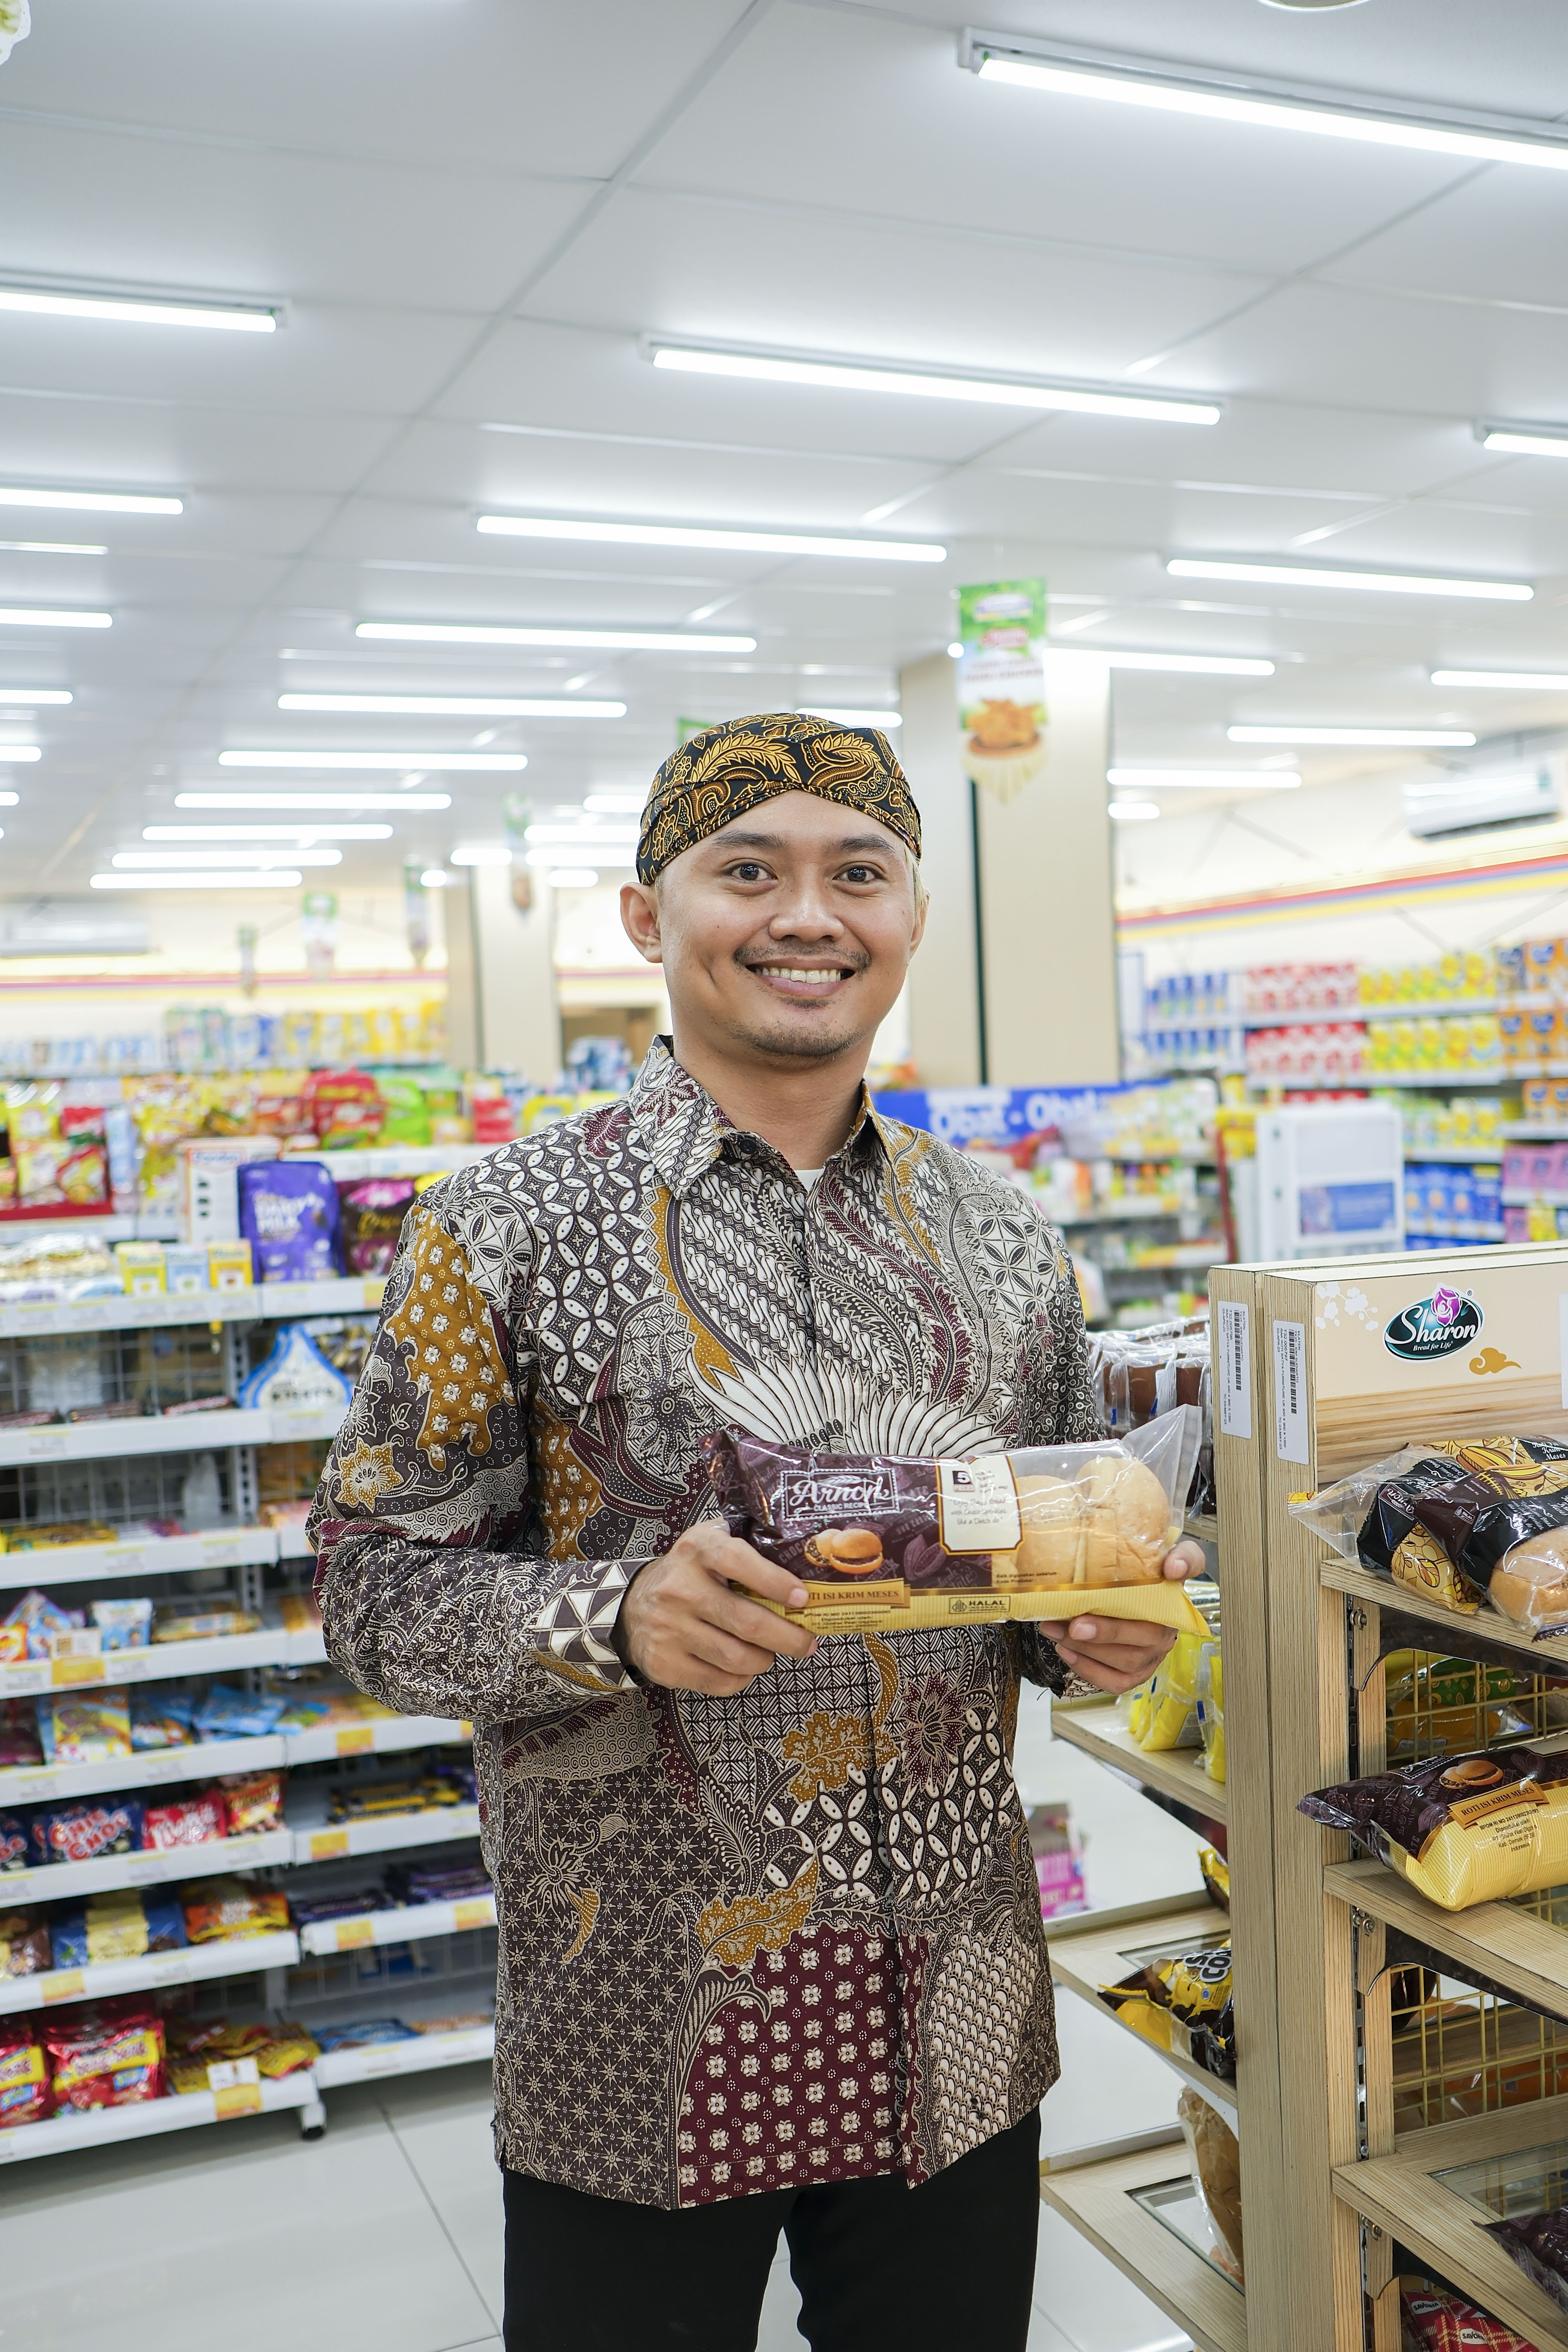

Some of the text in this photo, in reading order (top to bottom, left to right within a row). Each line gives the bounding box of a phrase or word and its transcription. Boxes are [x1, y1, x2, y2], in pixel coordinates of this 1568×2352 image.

[1385, 1305, 1476, 1344] Sharon
[1413, 1343, 1430, 1351] Bread
[957, 1472, 971, 1484] 5
[1540, 1517, 1555, 1527] Bread
[1461, 1804, 1482, 1816] ROTI
[1490, 1793, 1511, 1805] KRIM
[1511, 1787, 1535, 1798] MESES
[1511, 1843, 1530, 1852] Indonesia
[1413, 2302, 1439, 2311] SAVORIA
